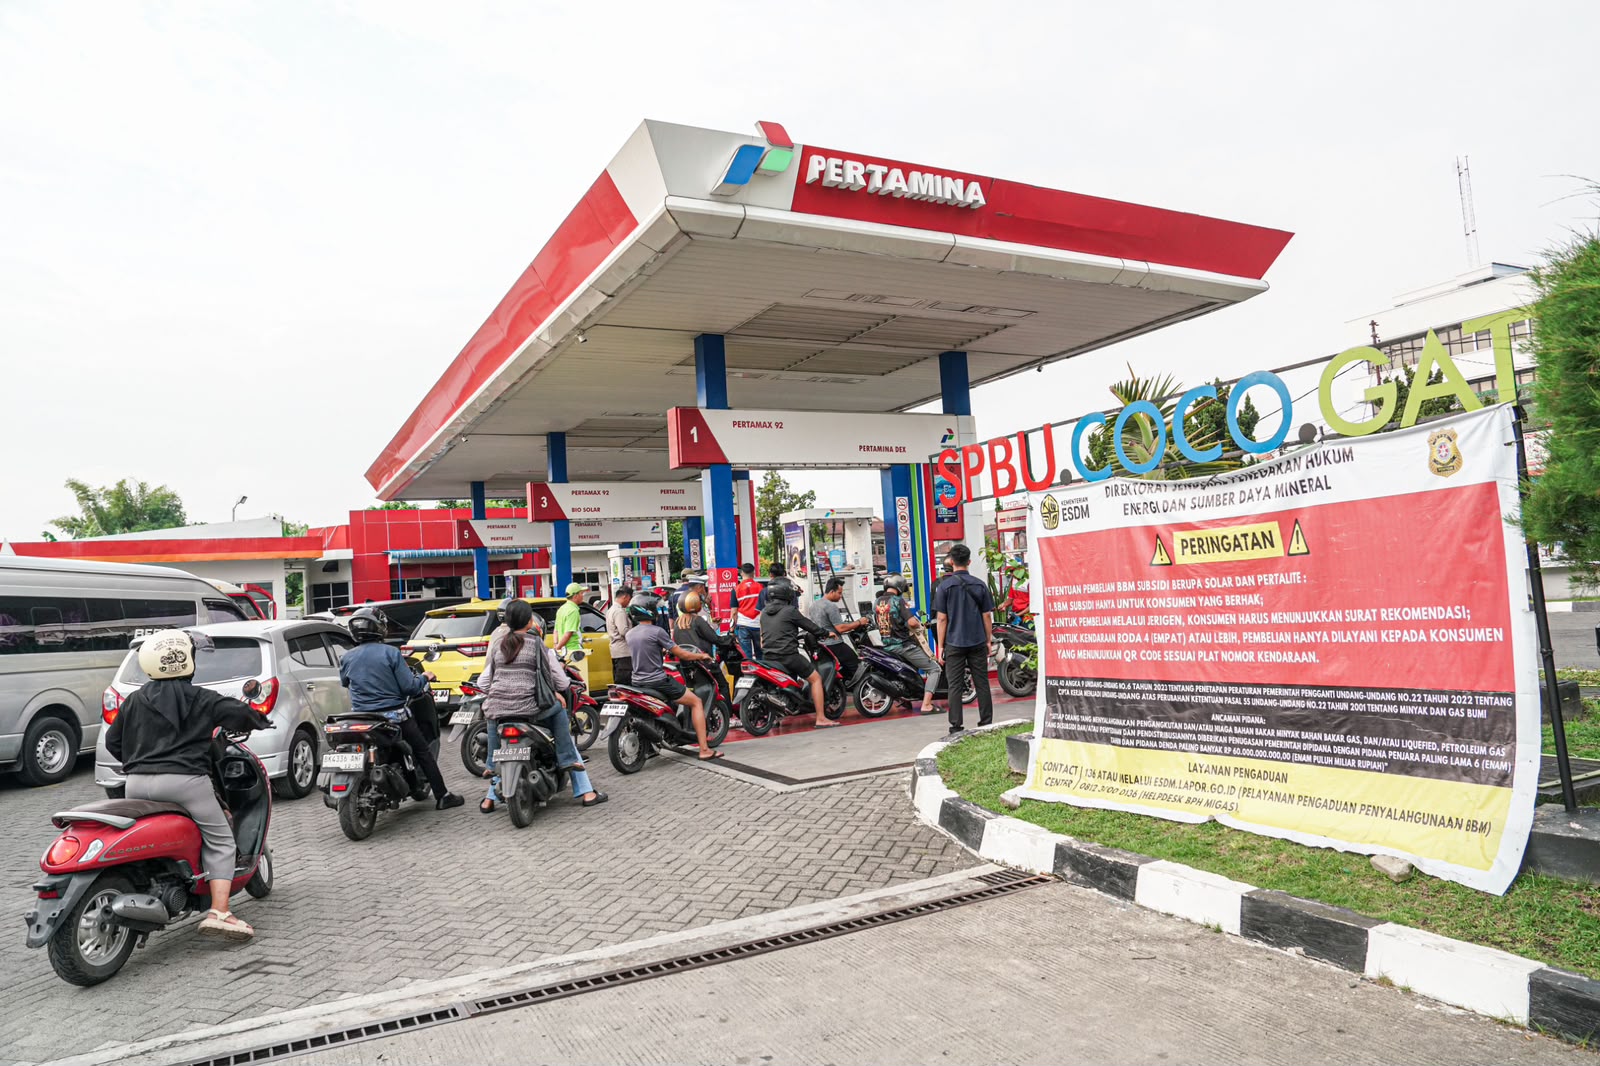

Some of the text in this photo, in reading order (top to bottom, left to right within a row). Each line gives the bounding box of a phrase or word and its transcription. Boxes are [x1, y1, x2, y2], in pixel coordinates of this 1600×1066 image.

[806, 155, 986, 209] PERTAMINA
[690, 426, 698, 443] 1
[1306, 446, 1354, 470] HUKUM
[540, 497, 548, 508] 3
[1123, 475, 1332, 516] ENERGI DAN SUMBER DAYA MINERAL
[1062, 504, 1090, 522] ESDM
[464, 530, 469, 539] 5
[1181, 530, 1275, 556] PERINGATAN
[1045, 575, 1256, 597] KETENTUAN PEMBELIAN BBM SUBSIDI BERUPA SOLAR DAN
[1070, 594, 1264, 611] SUBSIDI HANYA UNTUK KONSUMEN YANG BERHAK;
[1079, 605, 1470, 627] PEMBELIAN MELALUI JERIGEN, KONSUMEN HARUS MENUNJUKKAN SURAT REKOMENDASI;
[1080, 628, 1503, 645] KENDARAAN RODA 4 (EMPAT) ATAU LEBIH, PEMBELIAN HANYA DILAYANI KEPADA KONSUMEN
[1057, 650, 1319, 663] YANG MENUNJUKKAN QR CODE SESUAI PLAT NOMOR KENDARAAN.
[1132, 683, 1152, 691] TAHUN
[1168, 684, 1194, 692] TENTANG
[1196, 685, 1228, 694] PENETAPAN
[1228, 686, 1262, 695] PERATURAN
[1263, 688, 1300, 697] PEMERINTAH
[1301, 689, 1336, 698] PENGGANTI
[1336, 690, 1396, 701] UNDANG-UNDANG
[1398, 693, 1422, 703] NO.22
[1423, 694, 1449, 704] TAHUN
[1451, 695, 1473, 705] 2022
[1474, 696, 1513, 706] TENTANG
[1141, 693, 1487, 719] ATAS PERUBAHAN KETENTUAN PASAL UNDANG-UNDANG NO.22 TAHUN 2001 TENTANG MINYAK DAN GAS BUMI
[1211, 713, 1266, 725] ANCAMAN PIDANA:
[1136, 720, 1506, 757] PENGANGKUTAN DAN/ATAU NIAGA BAHAN BAKAR MINYAK BAHAN BAKAR GAS, DAN/ATAU LIQUEFIED, PETROLEUM GAS
[1122, 738, 1356, 768] DAN PIDANA DENDA PALING BANYAK (ENAM PULUH MILIAR
[1123, 729, 1511, 772] DAN PENDISTRIBUSIANNYA DIBERIKAN PENUGASAN PEMERINTAH DIPIDANA DENGAN PIDANA PENJARA PALING LAMA 6 (ENAM)
[1043, 762, 1078, 775] CONTACT
[1188, 762, 1288, 784] LAYANAN PENGADUAN
[1084, 768, 1492, 837] 136 ATAU ESDM.LAPOR.GO.ID (PELAYANAN PENGADUAN PENYALAHGUNAAN BBM)
[1138, 790, 1239, 812] (HELPDESK BPH MIGAS)
